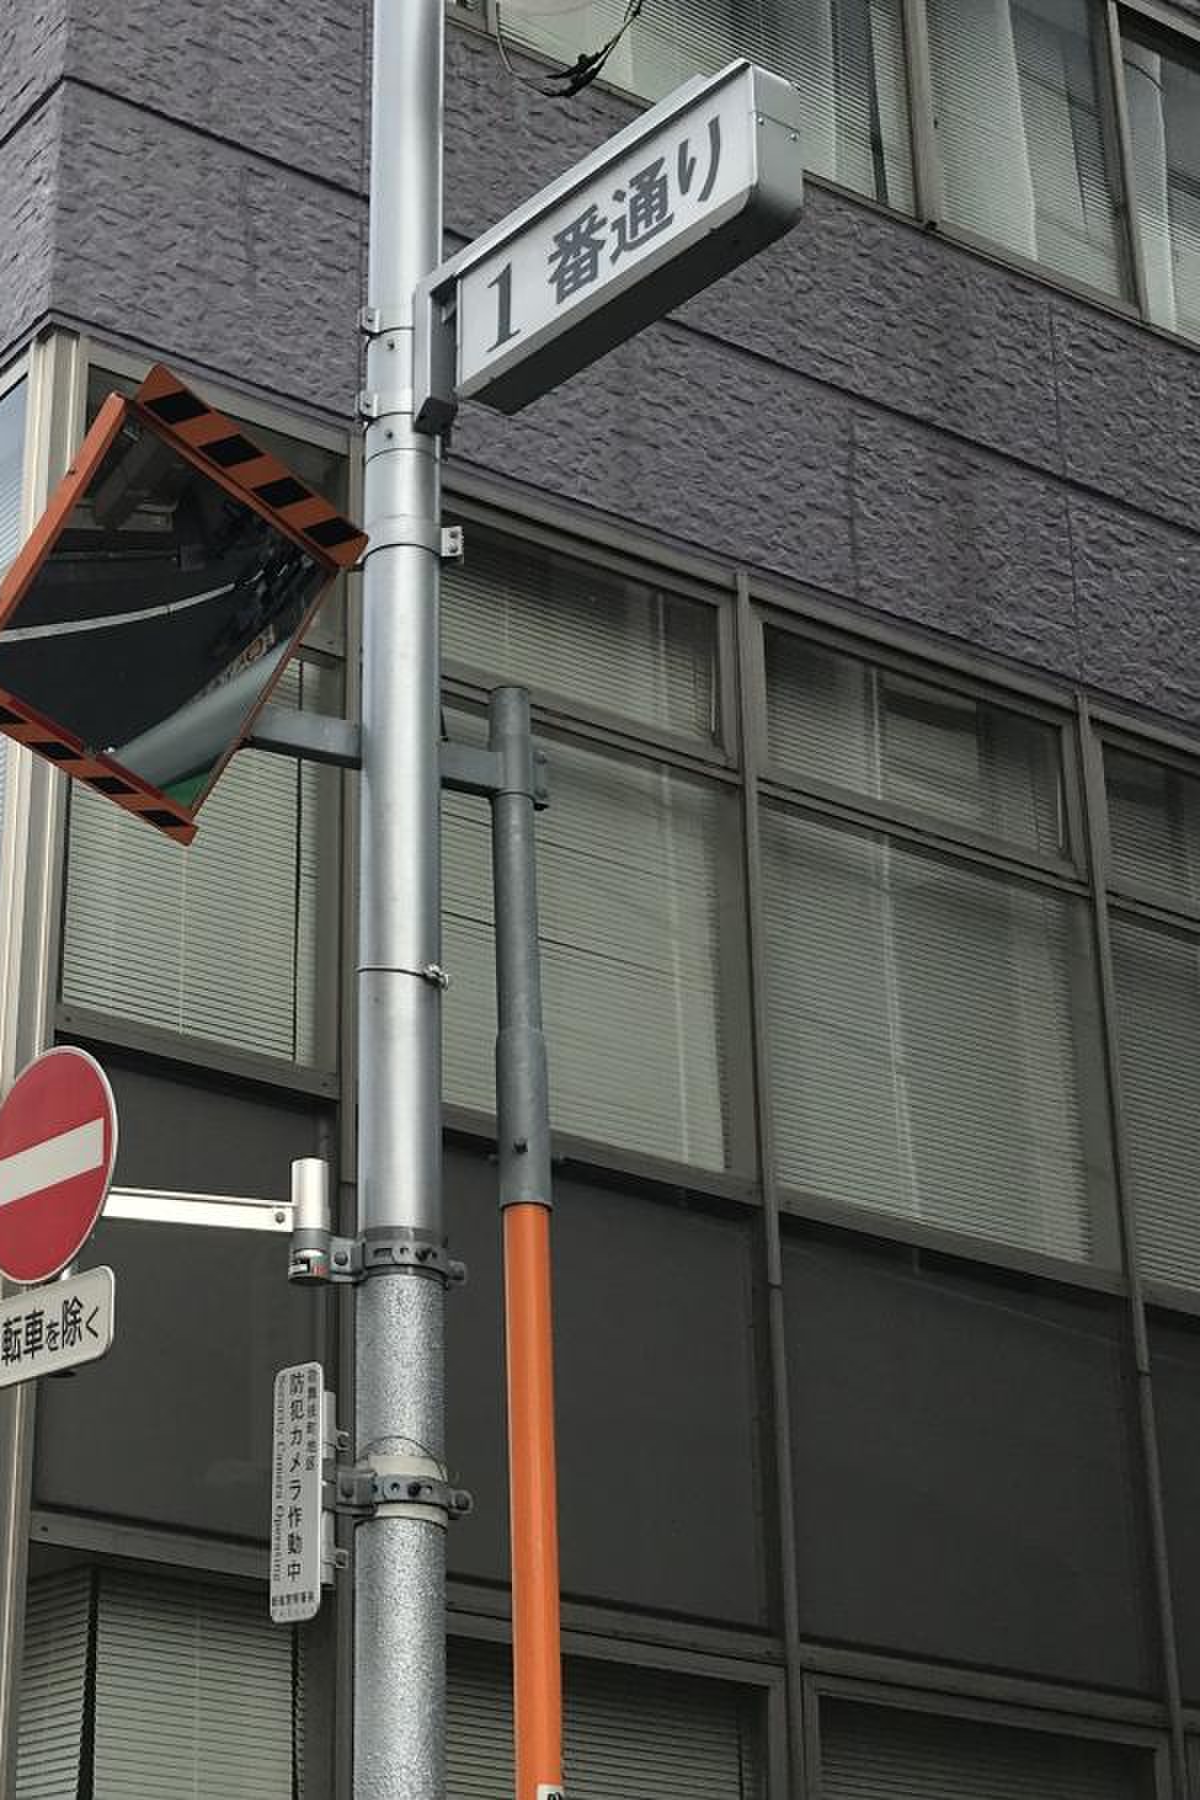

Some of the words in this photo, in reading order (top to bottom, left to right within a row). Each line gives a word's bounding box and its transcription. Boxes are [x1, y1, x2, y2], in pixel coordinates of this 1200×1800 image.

[486, 115, 721, 353] 1番通り
[287, 1371, 304, 1582] 防犯カメラ作動中
